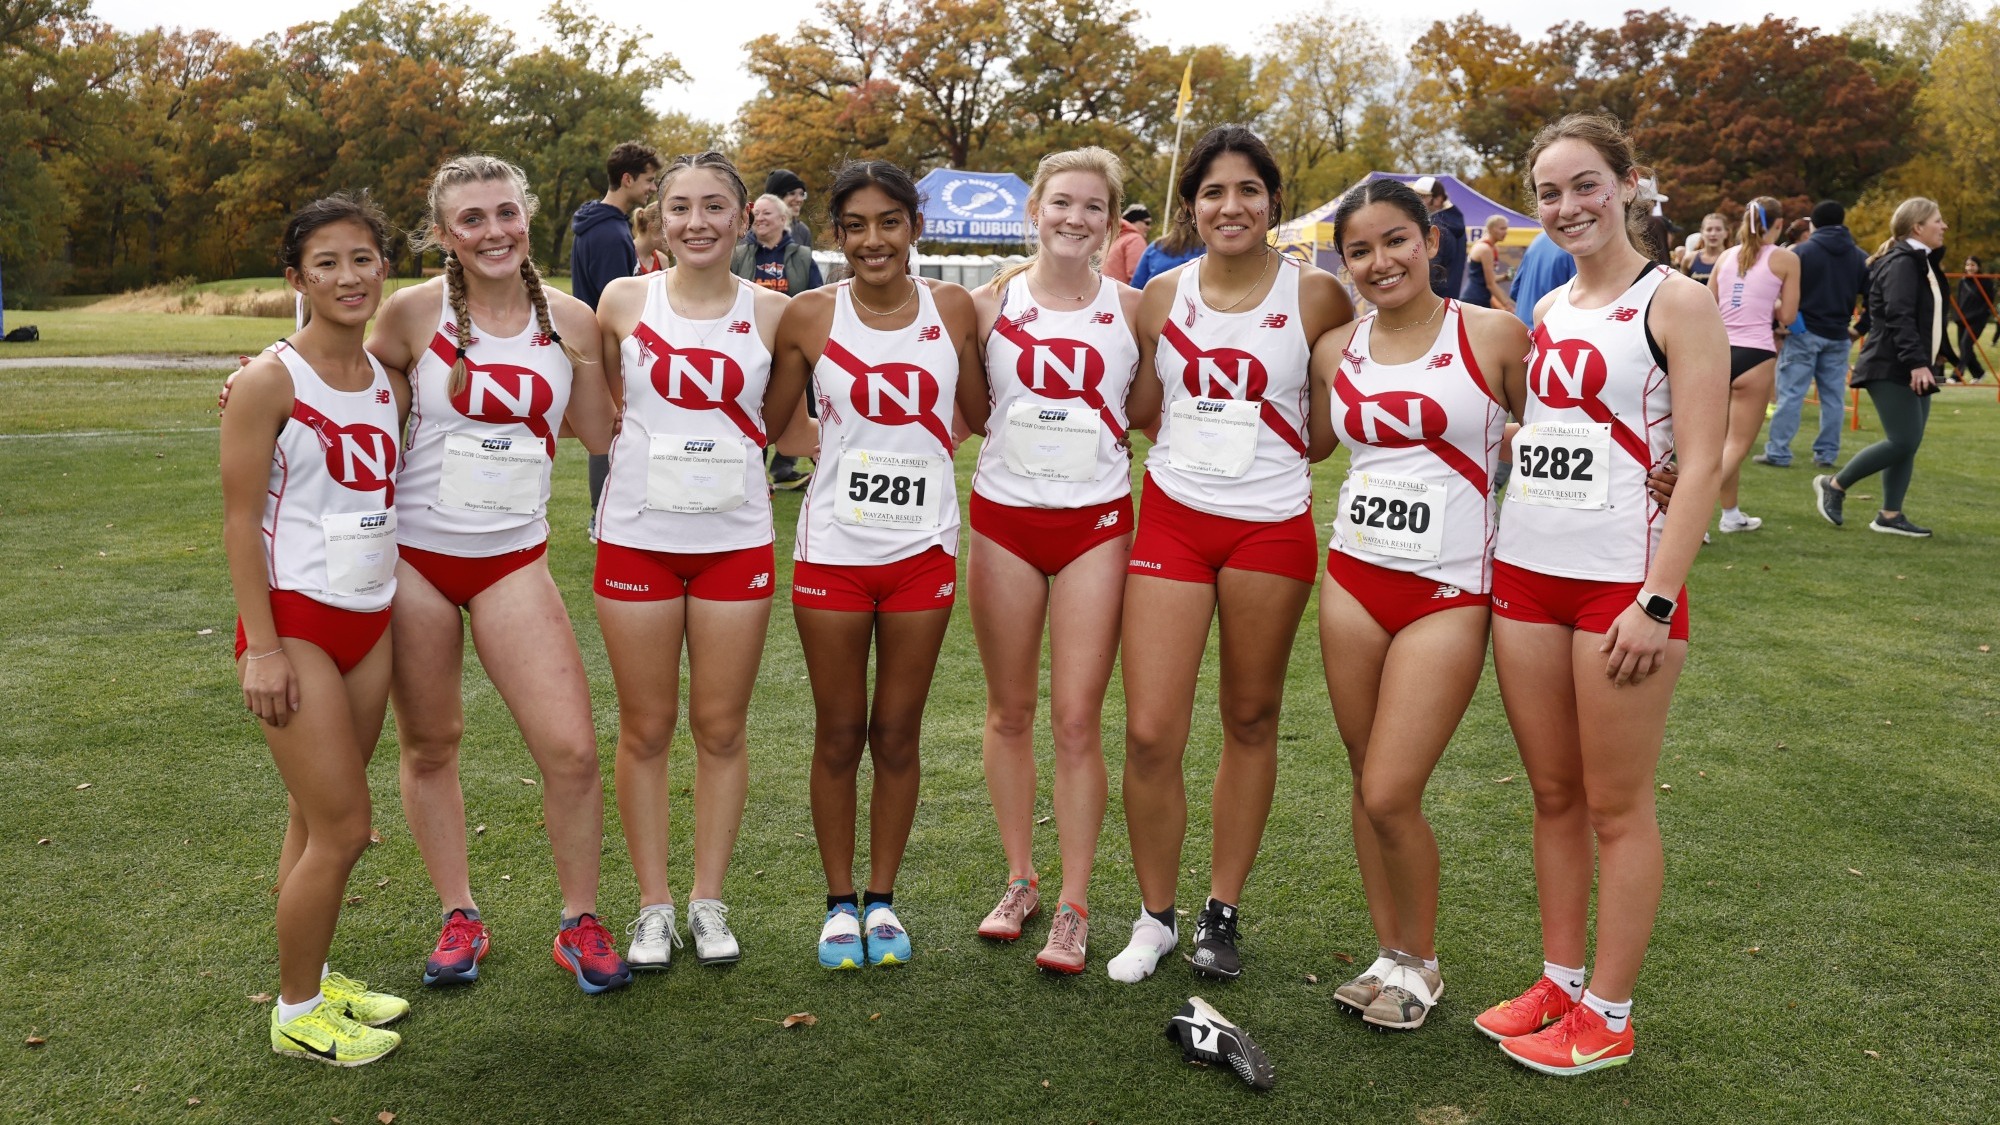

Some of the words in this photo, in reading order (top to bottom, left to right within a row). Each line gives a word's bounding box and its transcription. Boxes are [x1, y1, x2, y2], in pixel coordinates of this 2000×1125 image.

[925, 220, 966, 236] EAST
[969, 221, 1035, 236] DUBUQ
[1031, 344, 1089, 391] N
[1539, 348, 1593, 399] N
[666, 353, 727, 403] N
[1197, 357, 1252, 400] N
[466, 370, 535, 418] N
[865, 370, 922, 417] N
[1196, 401, 1226, 412] CCIW
[1038, 410, 1069, 421] CCIW
[1358, 398, 1427, 445] N
[481, 439, 512, 450] CCIW
[684, 441, 716, 452] CCIW
[338, 433, 388, 483] N
[868, 455, 900, 464] WAYZATA
[901, 458, 928, 466] RESULTS
[1520, 445, 1594, 481] 5282
[849, 472, 926, 506] 5281
[1368, 478, 1396, 486] WAYZATA
[1397, 481, 1428, 490] RESULTS
[1527, 487, 1555, 496] WAYZATA
[1556, 490, 1587, 498] RESULTS
[360, 515, 387, 527] CCIW
[862, 511, 894, 520] WAYZATA
[895, 514, 922, 522] RESULTS
[1350, 495, 1431, 534] 5280
[1362, 535, 1389, 545] WAYZATA
[1390, 540, 1421, 550] RESULTS
[605, 579, 649, 592] CARDINALS
